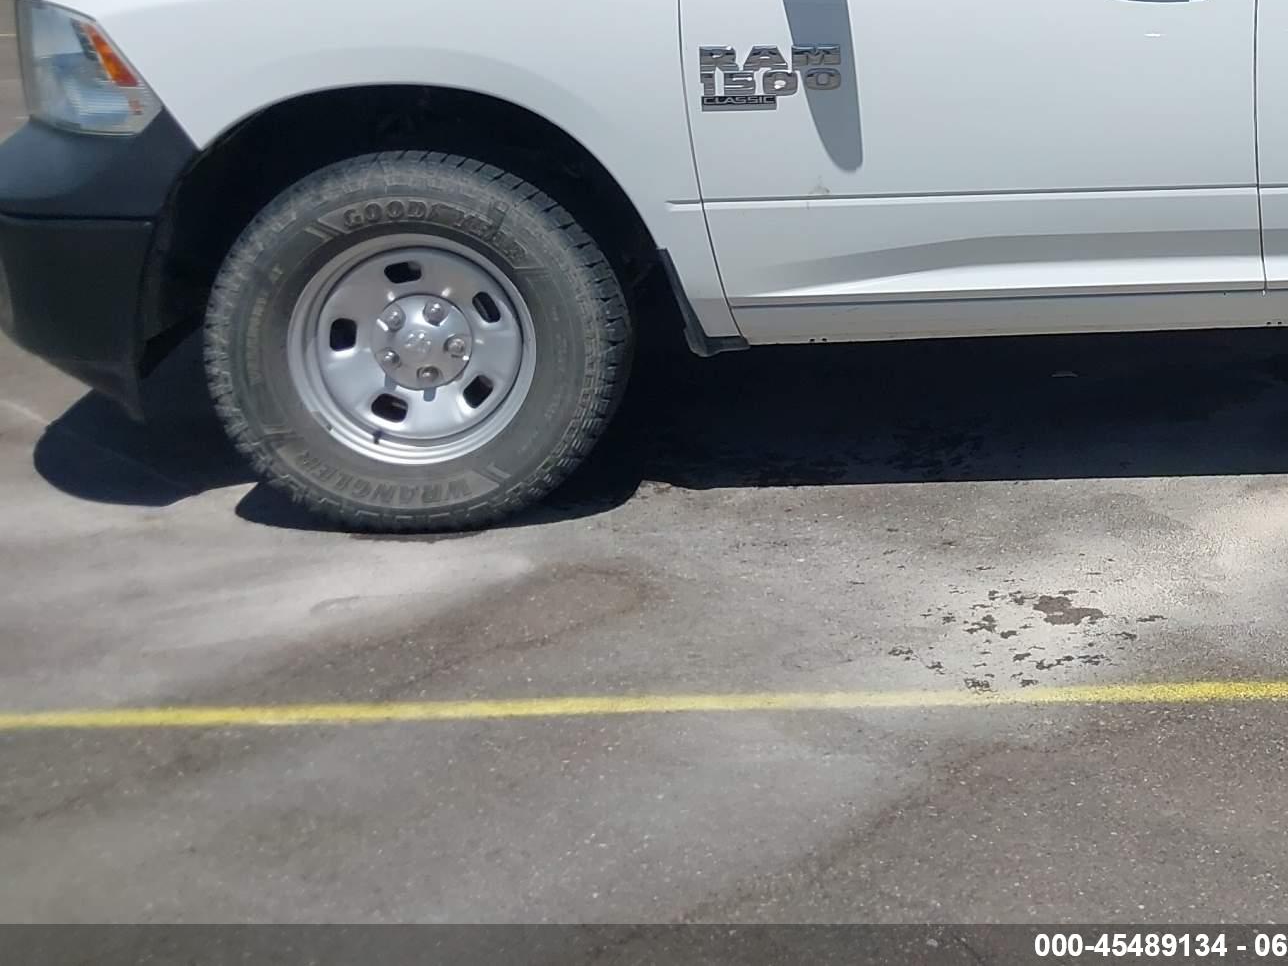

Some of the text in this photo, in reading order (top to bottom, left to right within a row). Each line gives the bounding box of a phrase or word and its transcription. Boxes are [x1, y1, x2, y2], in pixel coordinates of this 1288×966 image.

[699, 45, 842, 71] RAM
[699, 68, 842, 97] 1500
[703, 95, 776, 105] CLASSIC
[295, 448, 473, 504] WRANGLER
